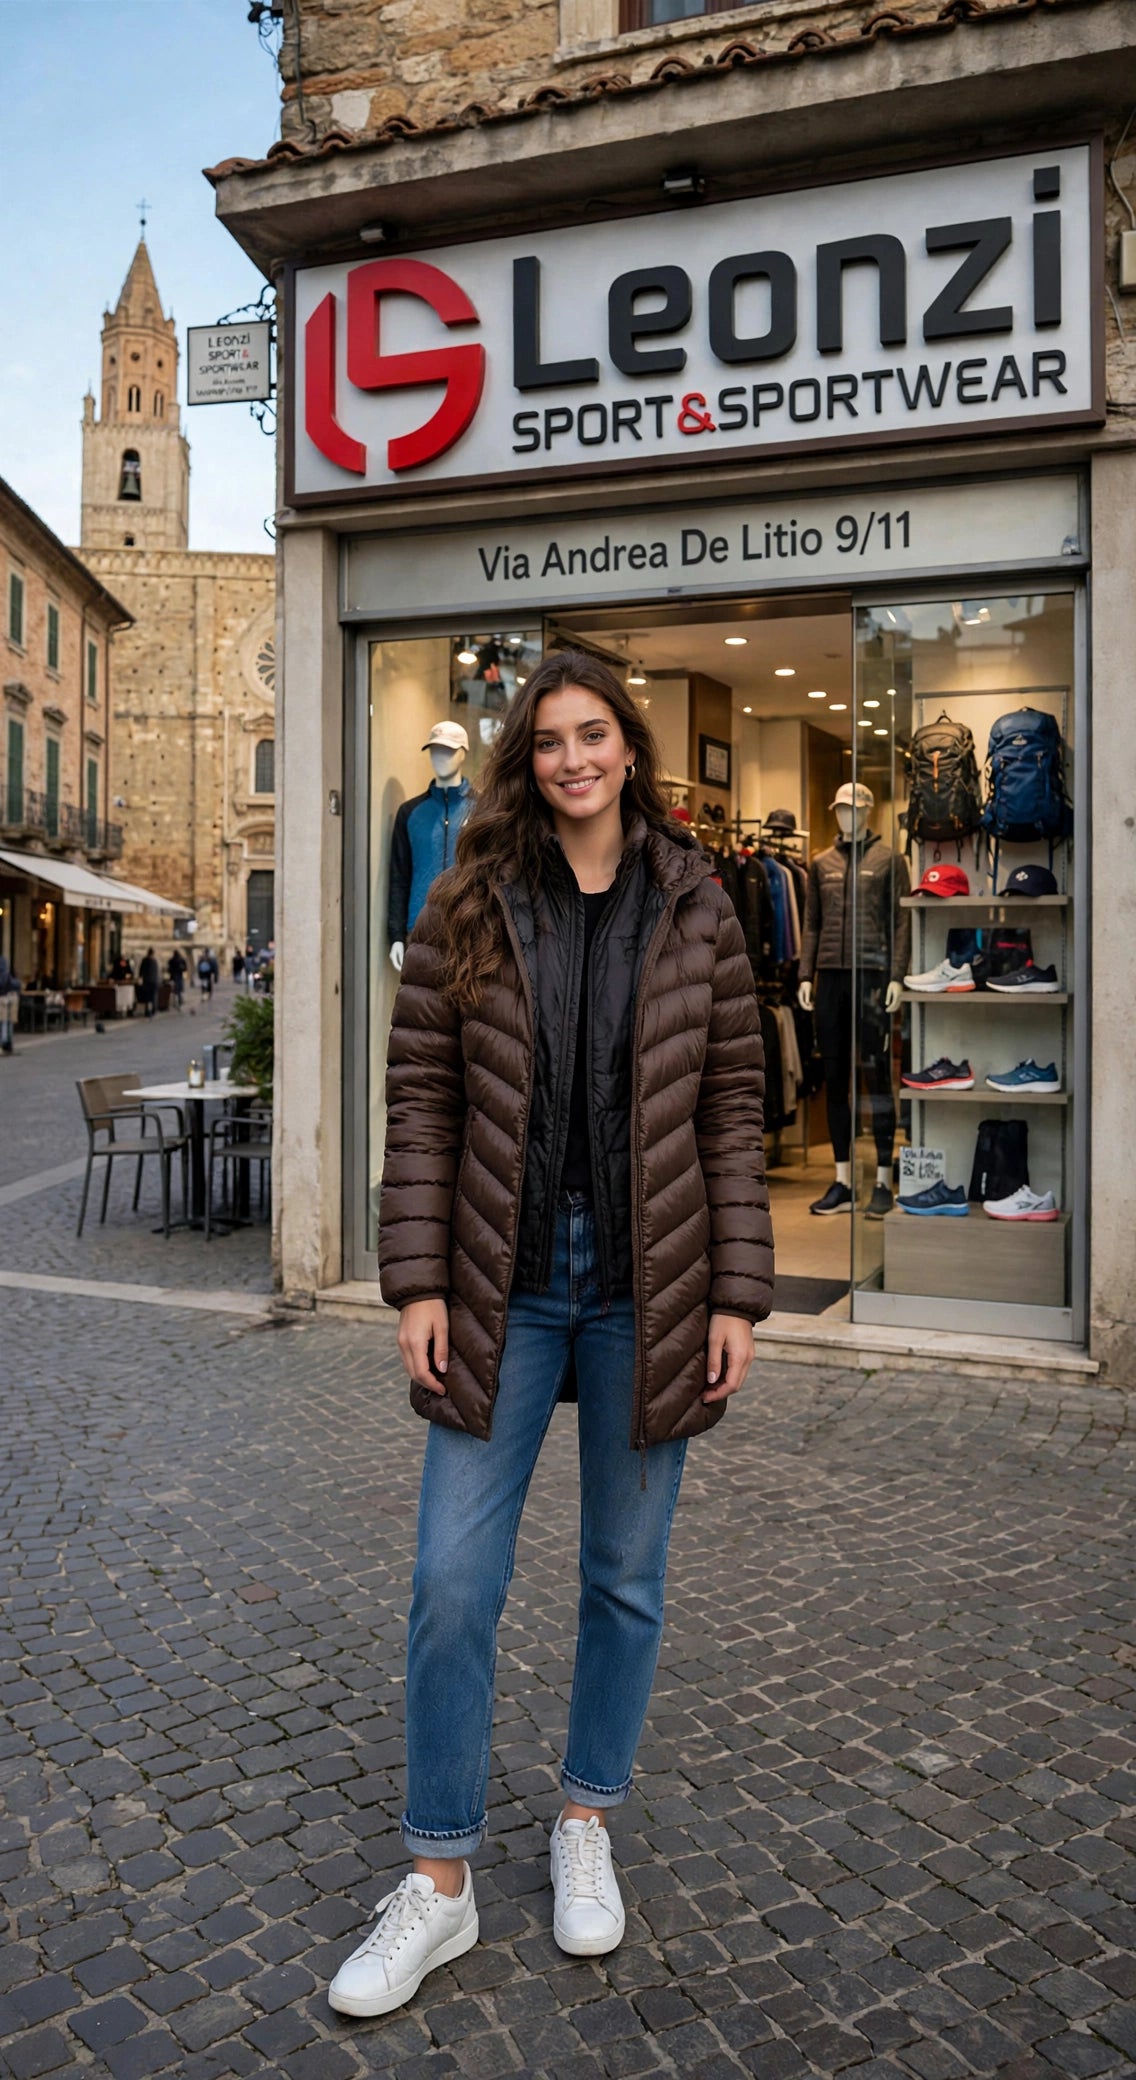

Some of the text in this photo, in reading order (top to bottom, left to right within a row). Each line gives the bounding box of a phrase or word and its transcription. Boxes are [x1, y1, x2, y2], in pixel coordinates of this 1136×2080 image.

[512, 165, 1062, 390] Leonzi
[512, 349, 1068, 453] SPORT&SPORTWEAR
[479, 511, 911, 582] Via Andrea De Litio 9/11
